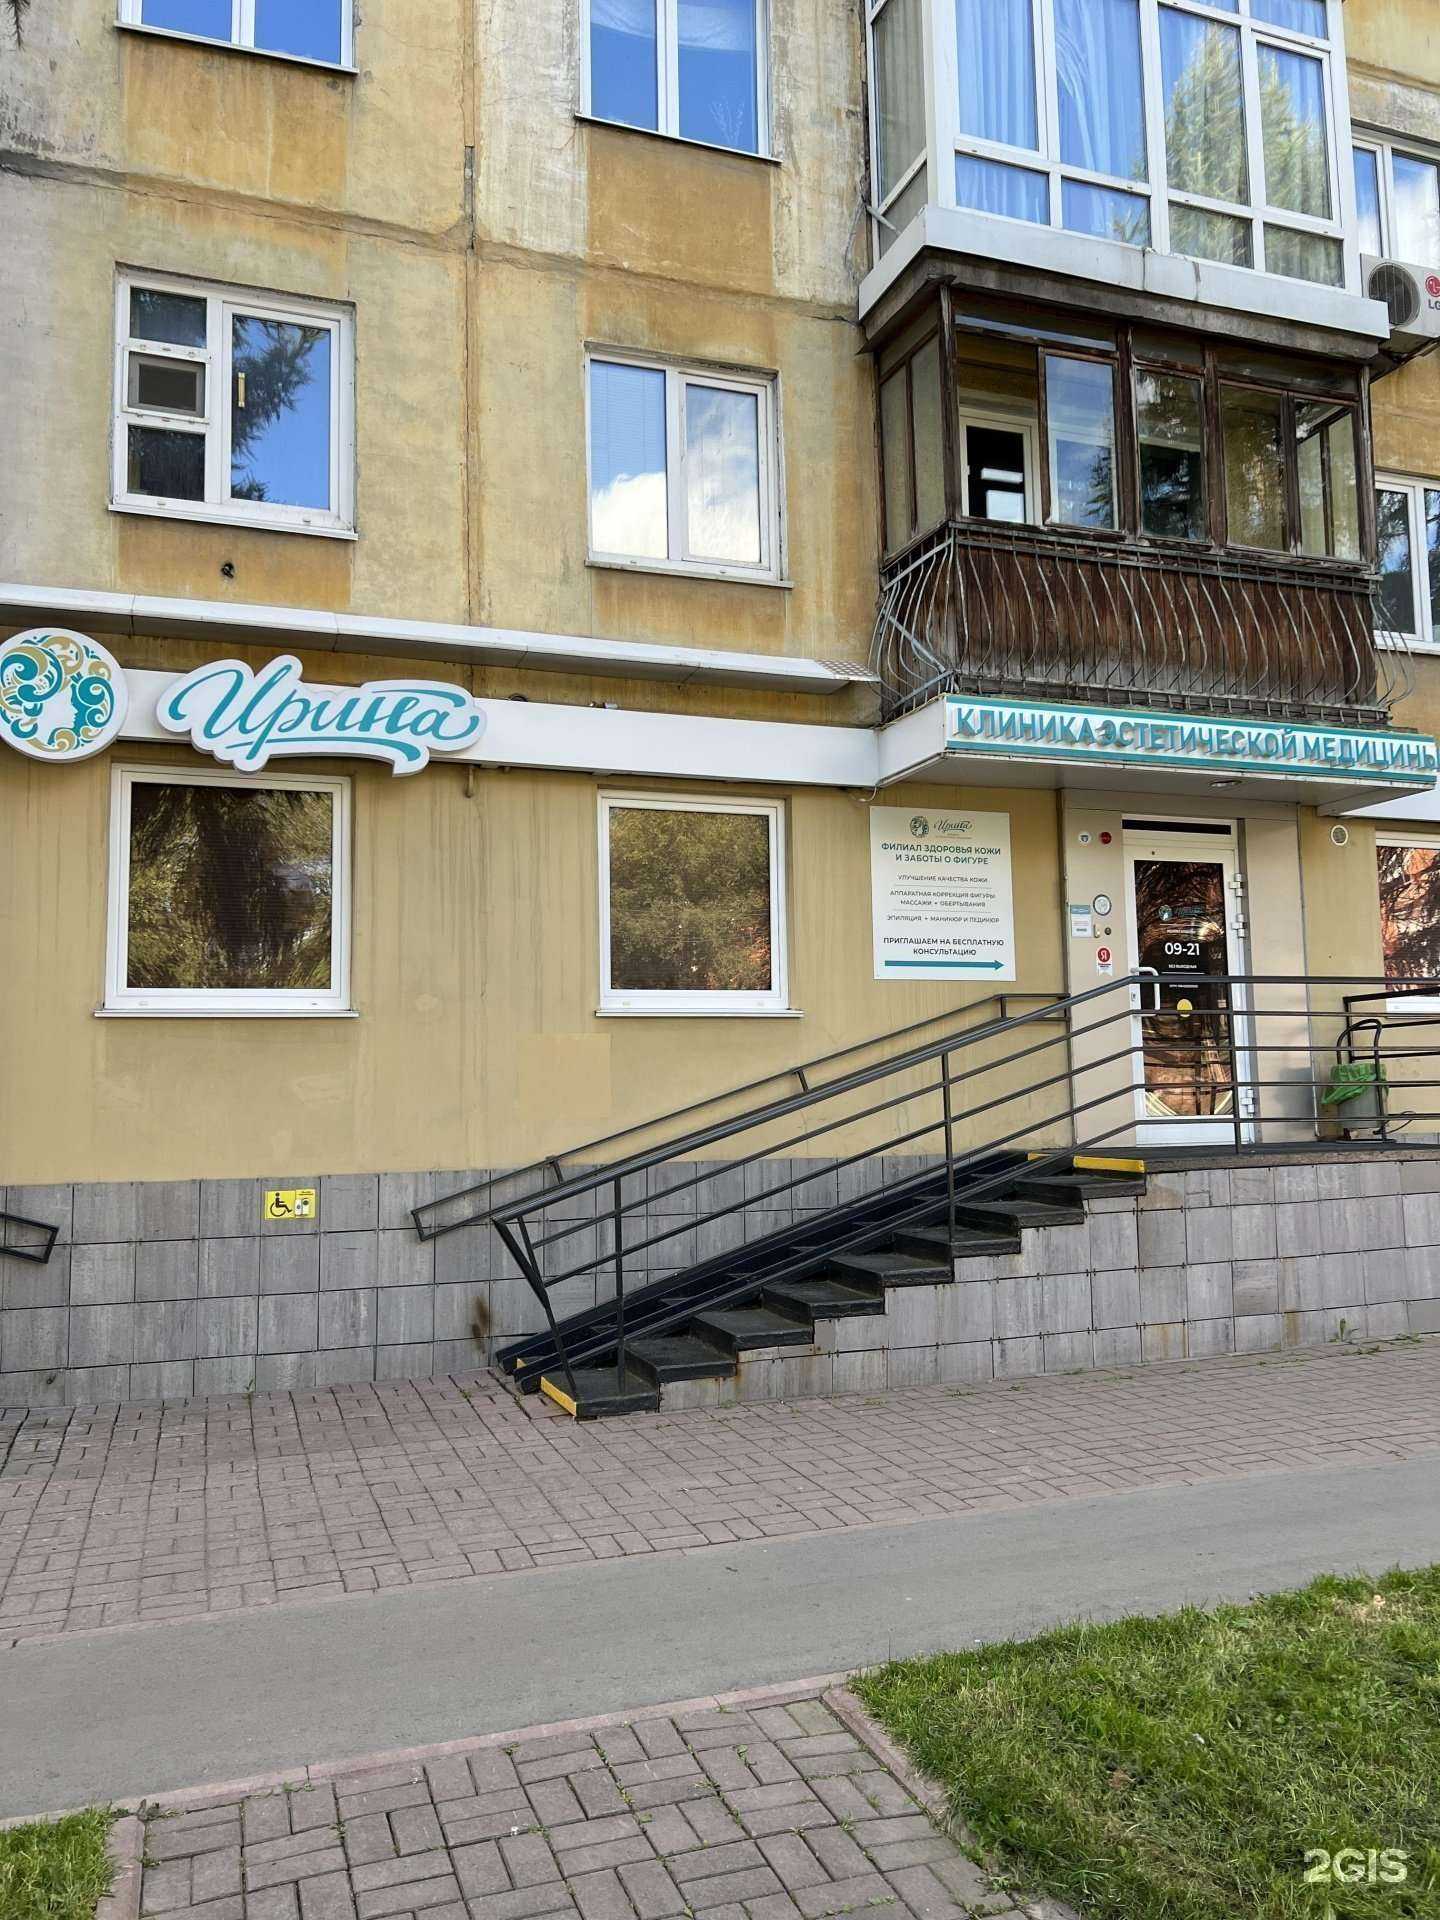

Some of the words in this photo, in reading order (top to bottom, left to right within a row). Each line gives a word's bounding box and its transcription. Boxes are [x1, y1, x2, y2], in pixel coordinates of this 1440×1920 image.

[170, 664, 479, 761] Ирина
[955, 707, 1096, 745] КЛИНИКА
[1097, 720, 1298, 759] ЭСТЕТИЧЕСКОЙ
[1302, 735, 1440, 771] МЕДИЦИНЫ
[881, 843, 922, 852] ФИЛИАЛ
[924, 845, 972, 854] ЗДОРОВЬЯ
[975, 847, 1001, 855] КОЖИ
[905, 854, 942, 862] ЗАБОТЫ
[953, 856, 988, 865] ФИГУРЕ
[883, 937, 938, 945] ПРИГЛАШАЕМ
[952, 938, 1004, 946] БЕСПЛАТНУЮ
[913, 948, 977, 956] КОНСУЛЬТАЦИЮ
[1164, 942, 1200, 956] 09-21
